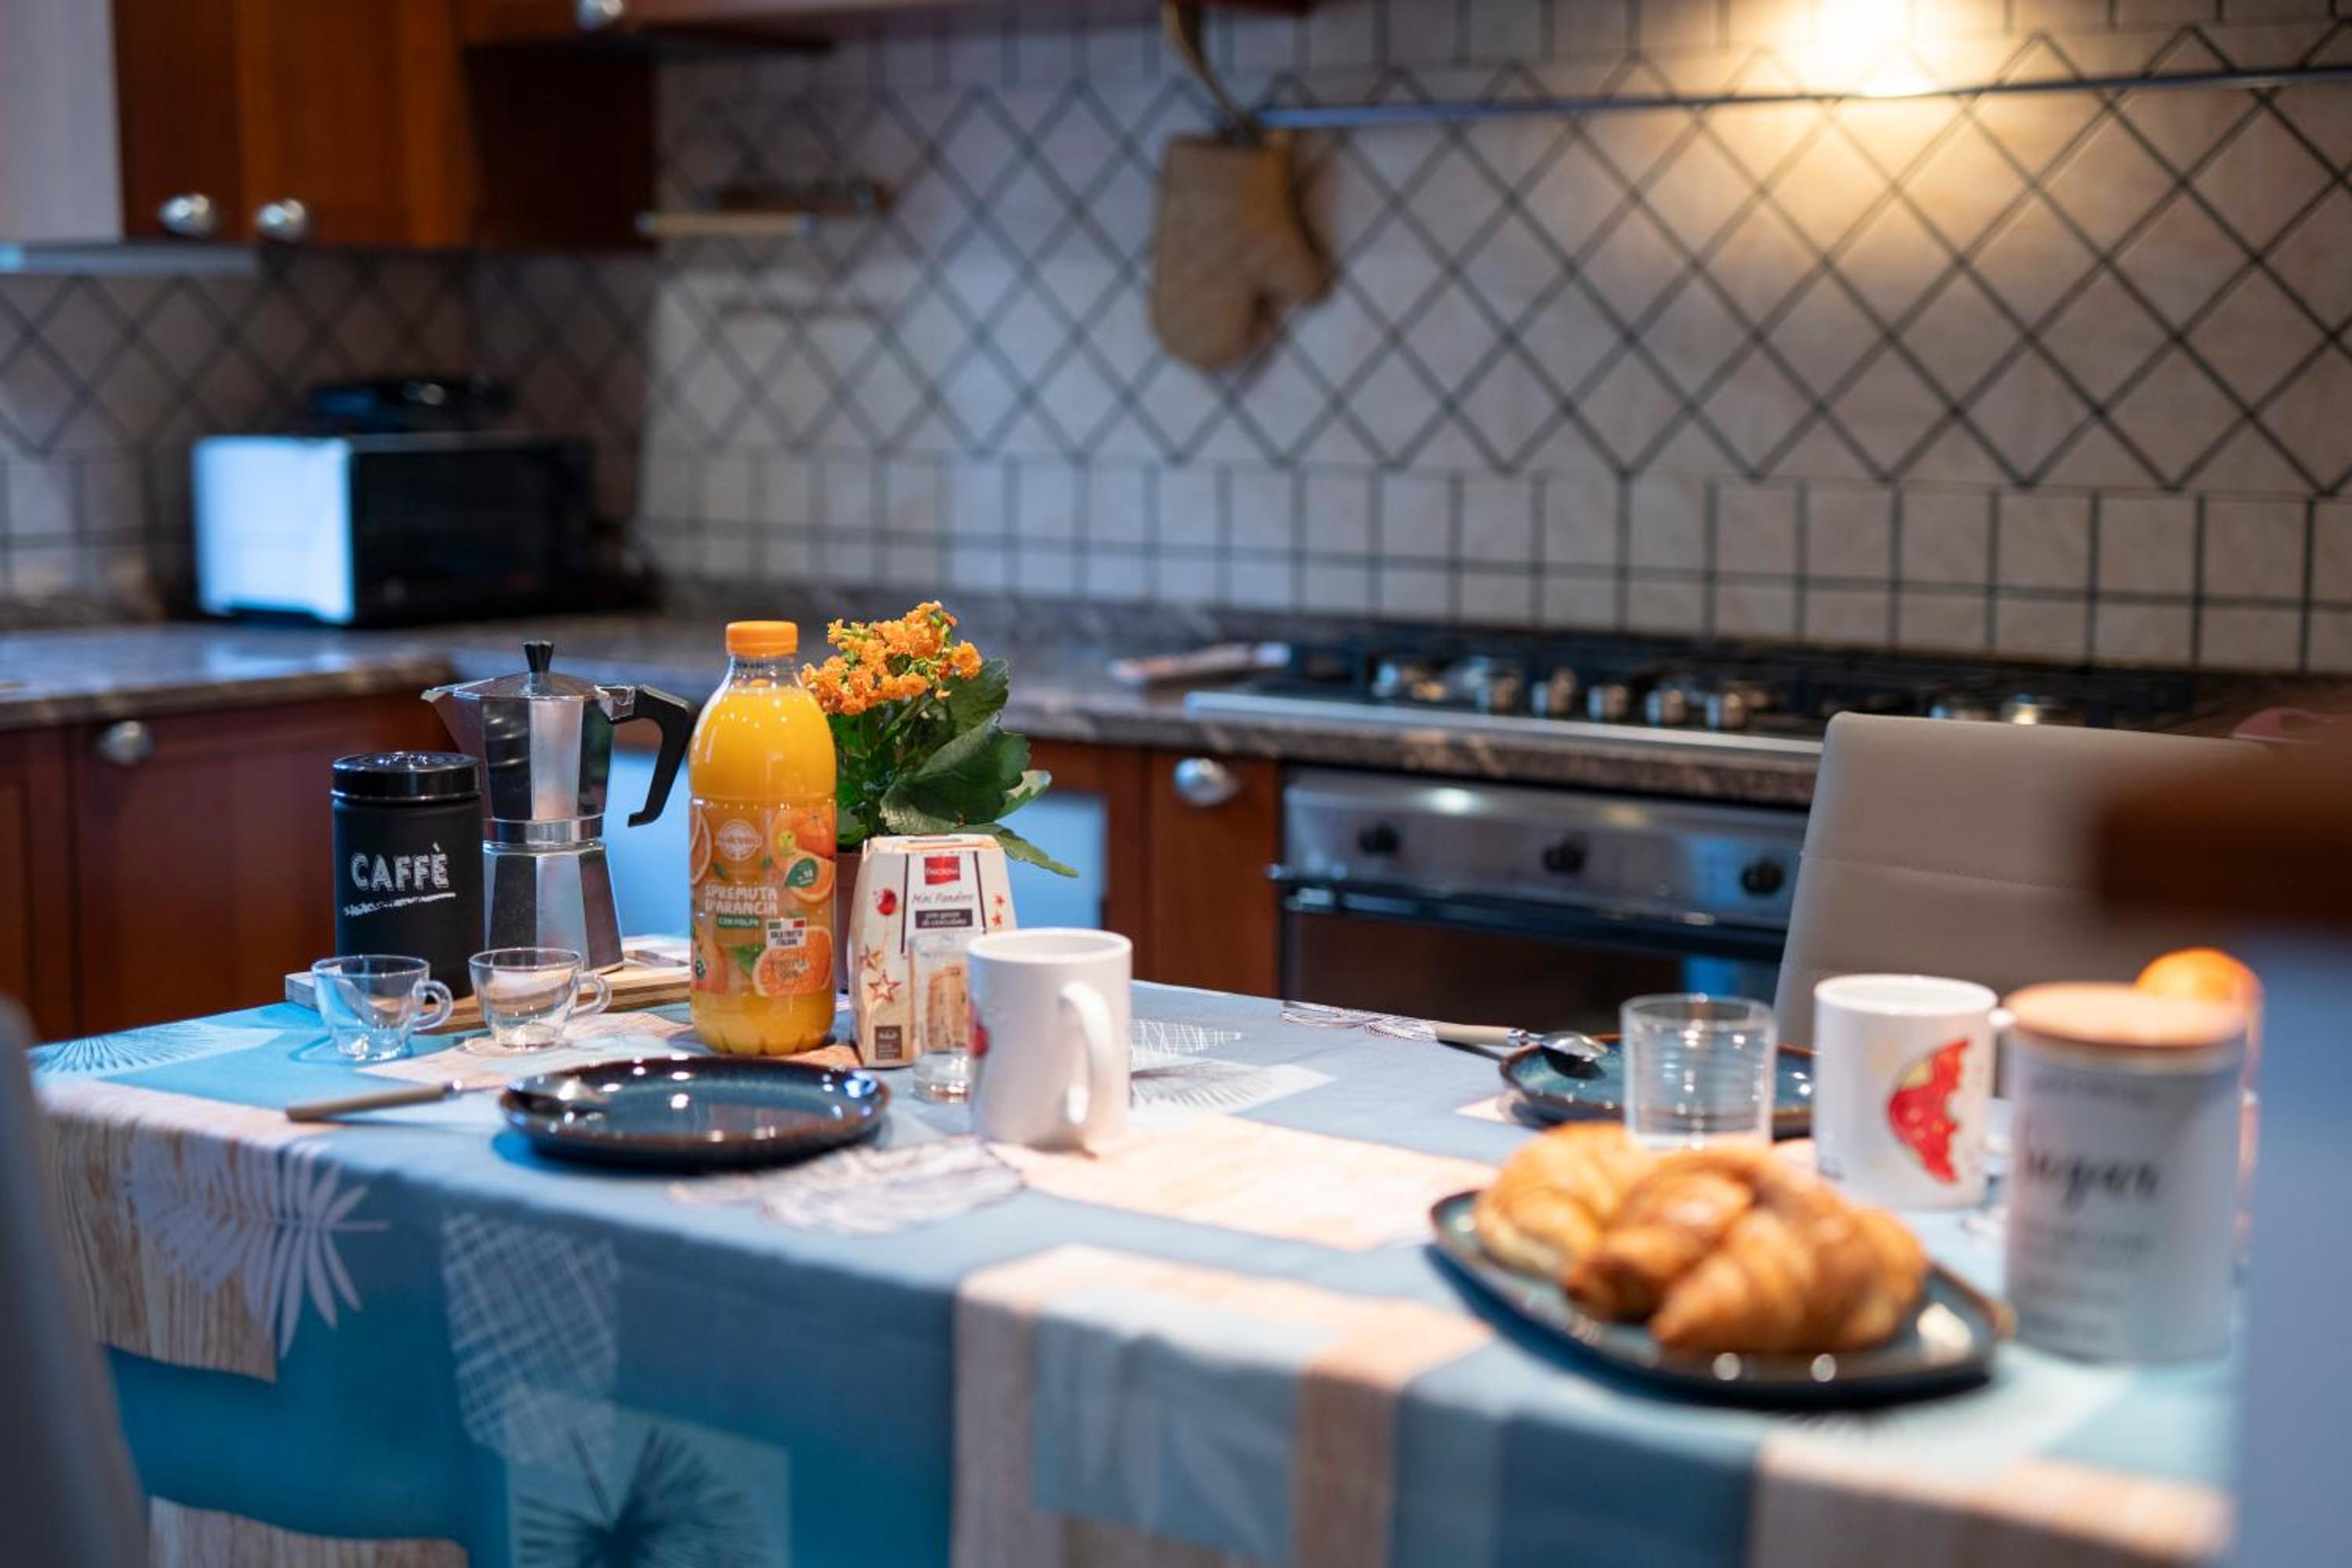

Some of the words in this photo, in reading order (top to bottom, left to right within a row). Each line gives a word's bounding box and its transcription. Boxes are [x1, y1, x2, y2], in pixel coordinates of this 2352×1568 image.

[350, 842, 450, 891] CAFFÈ
[704, 884, 778, 901] SPREMUTA
[704, 898, 778, 916] D'ARANCIA
